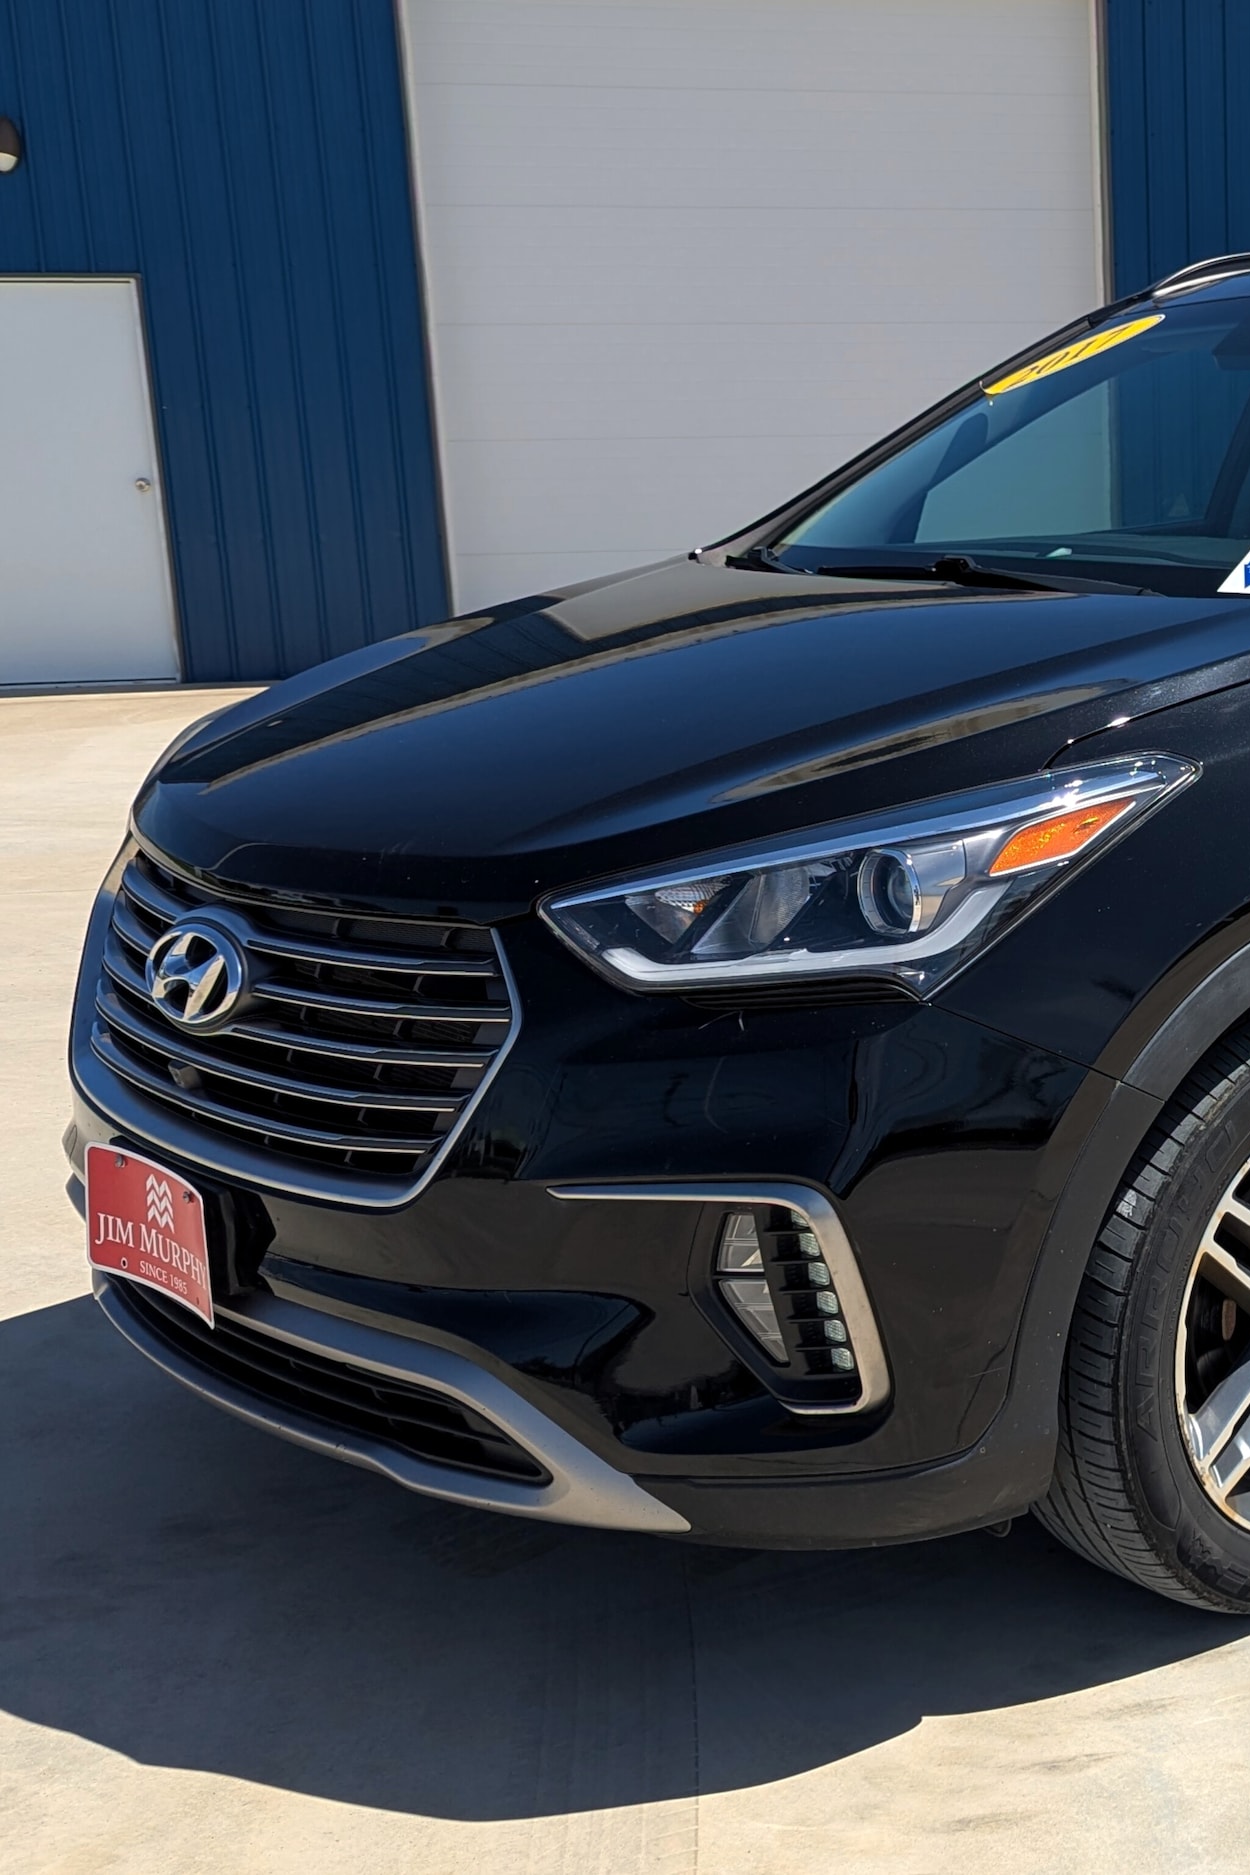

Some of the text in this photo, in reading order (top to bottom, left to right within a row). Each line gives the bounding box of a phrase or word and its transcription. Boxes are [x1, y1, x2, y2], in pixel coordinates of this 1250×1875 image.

[1000, 324, 1135, 392] 2017
[96, 1213, 206, 1290] JIM MURPHY
[140, 1261, 188, 1295] SINCE 1985
